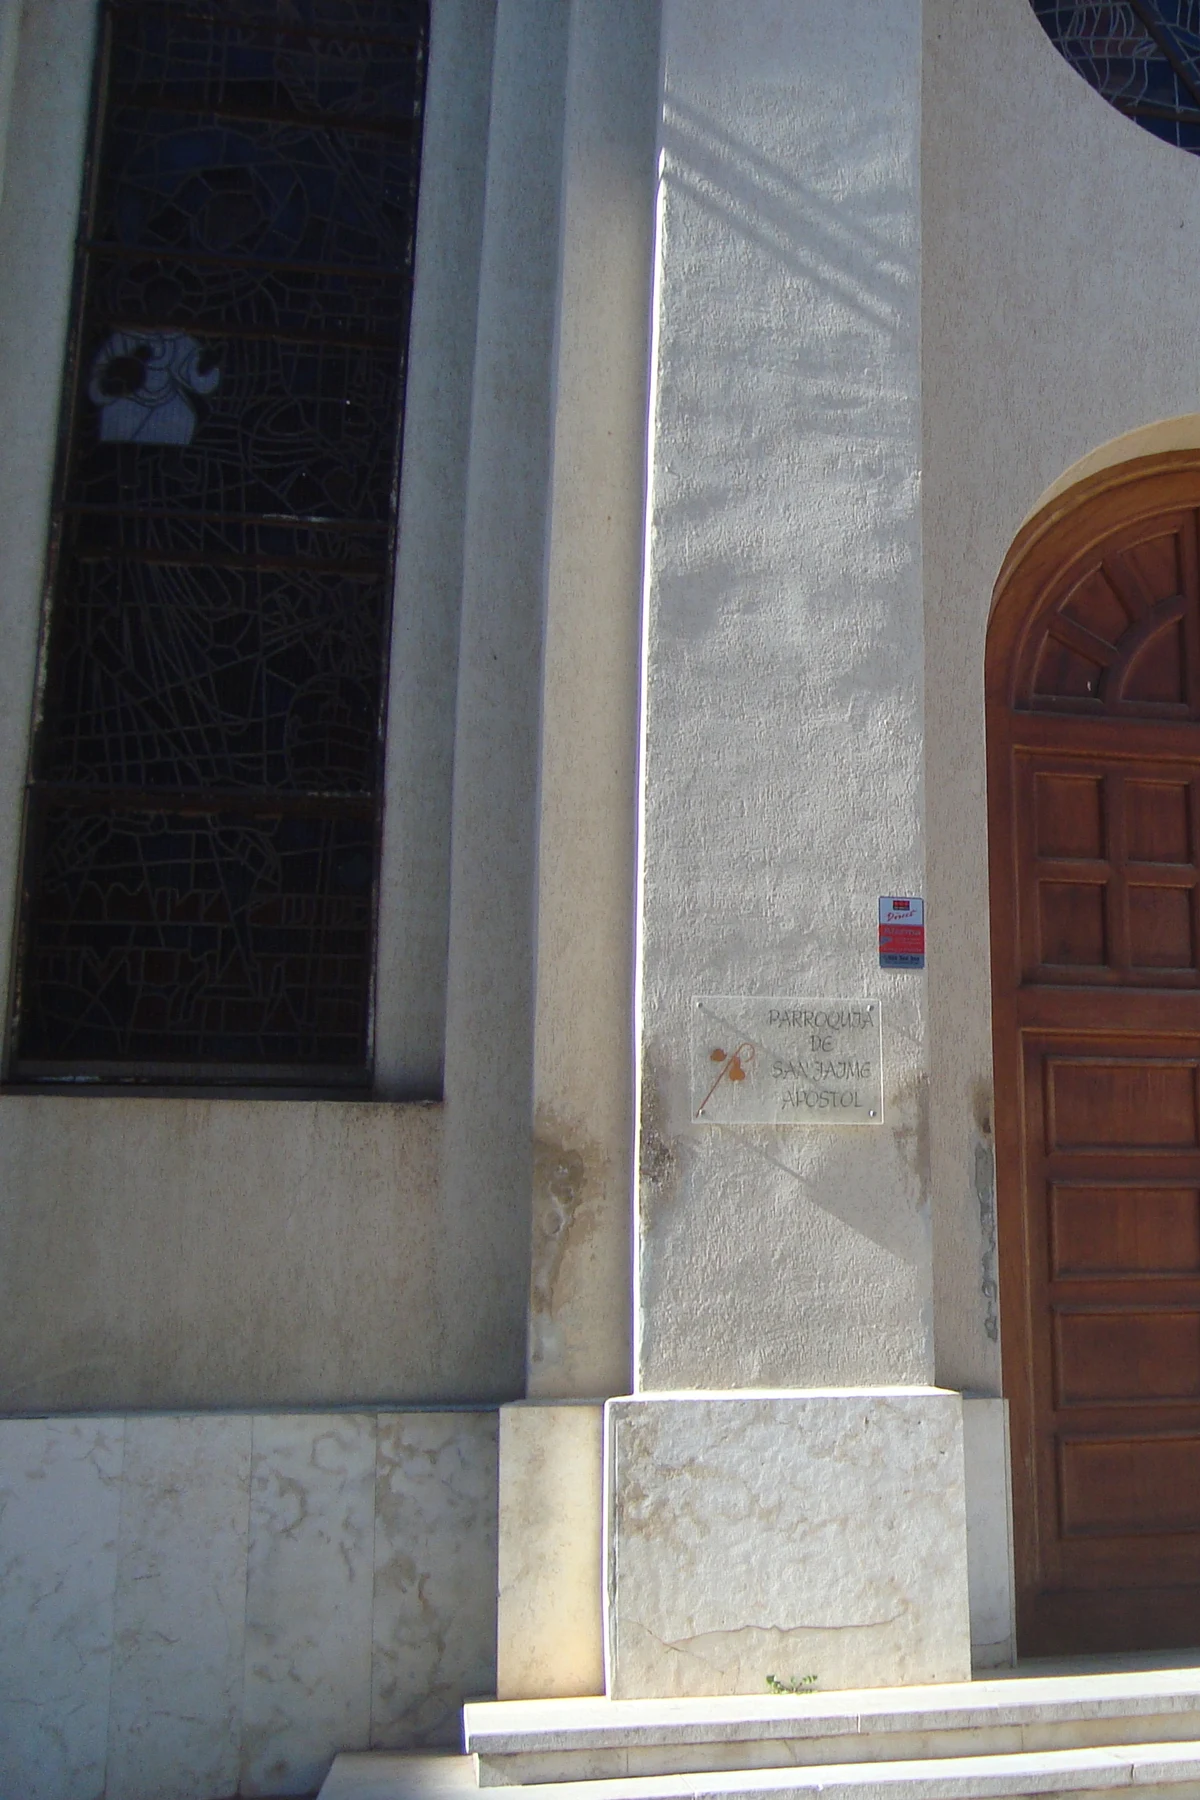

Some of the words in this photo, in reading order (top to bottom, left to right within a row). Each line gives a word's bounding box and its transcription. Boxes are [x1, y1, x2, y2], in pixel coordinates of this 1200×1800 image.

[810, 1035, 834, 1052] DE
[772, 1061, 809, 1079] SAN
[781, 1091, 864, 1109] APOSTOL
